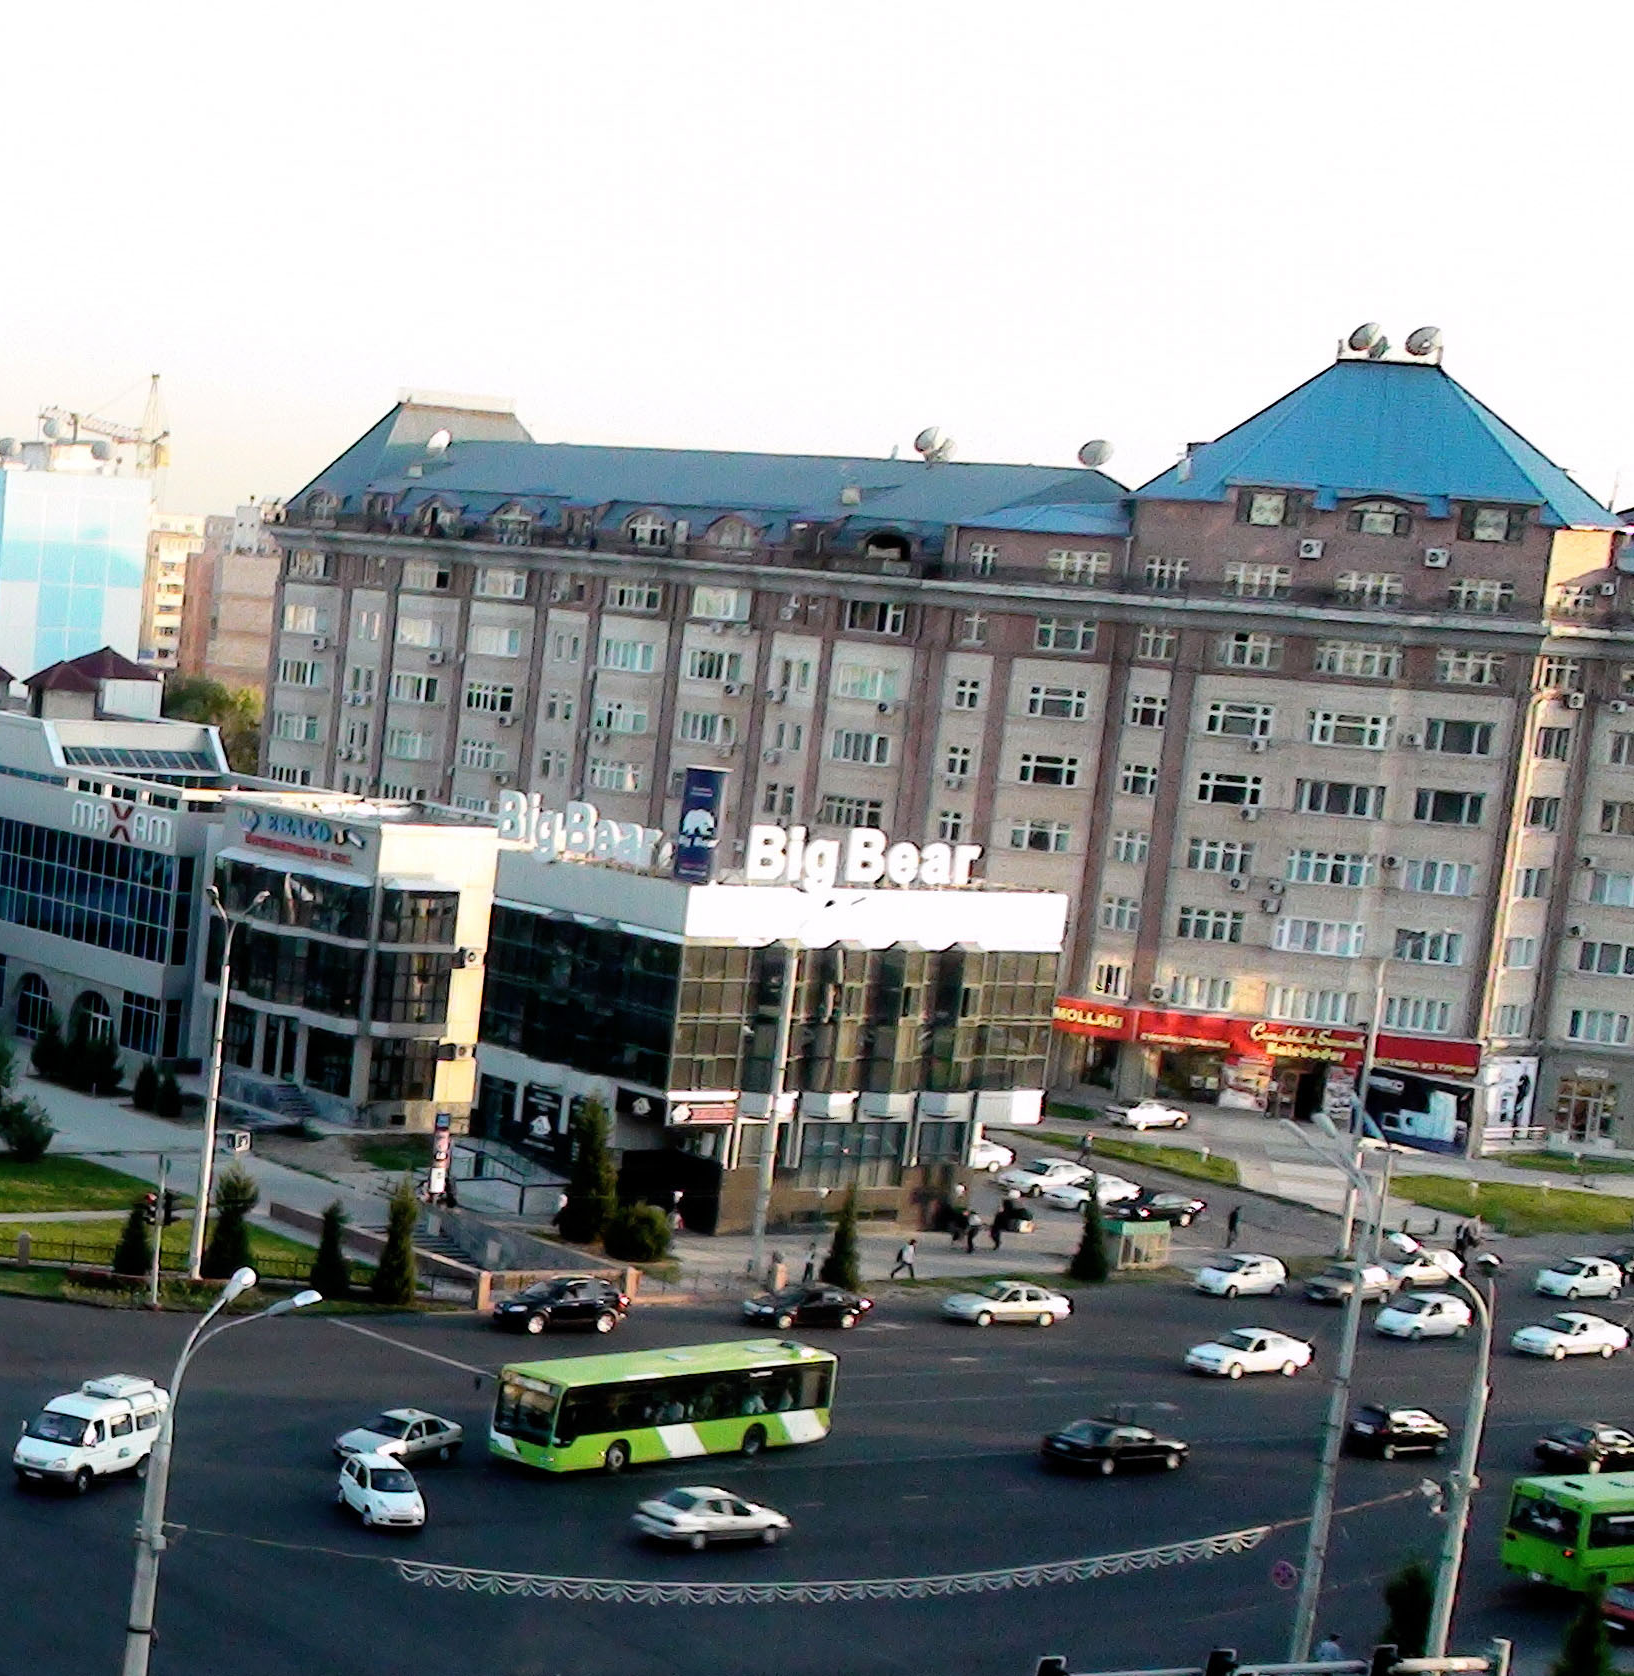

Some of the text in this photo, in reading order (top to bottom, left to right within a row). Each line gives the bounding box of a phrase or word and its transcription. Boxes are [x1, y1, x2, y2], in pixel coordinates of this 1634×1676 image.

[499, 788, 564, 863] Big
[746, 823, 984, 893] Big Bear
